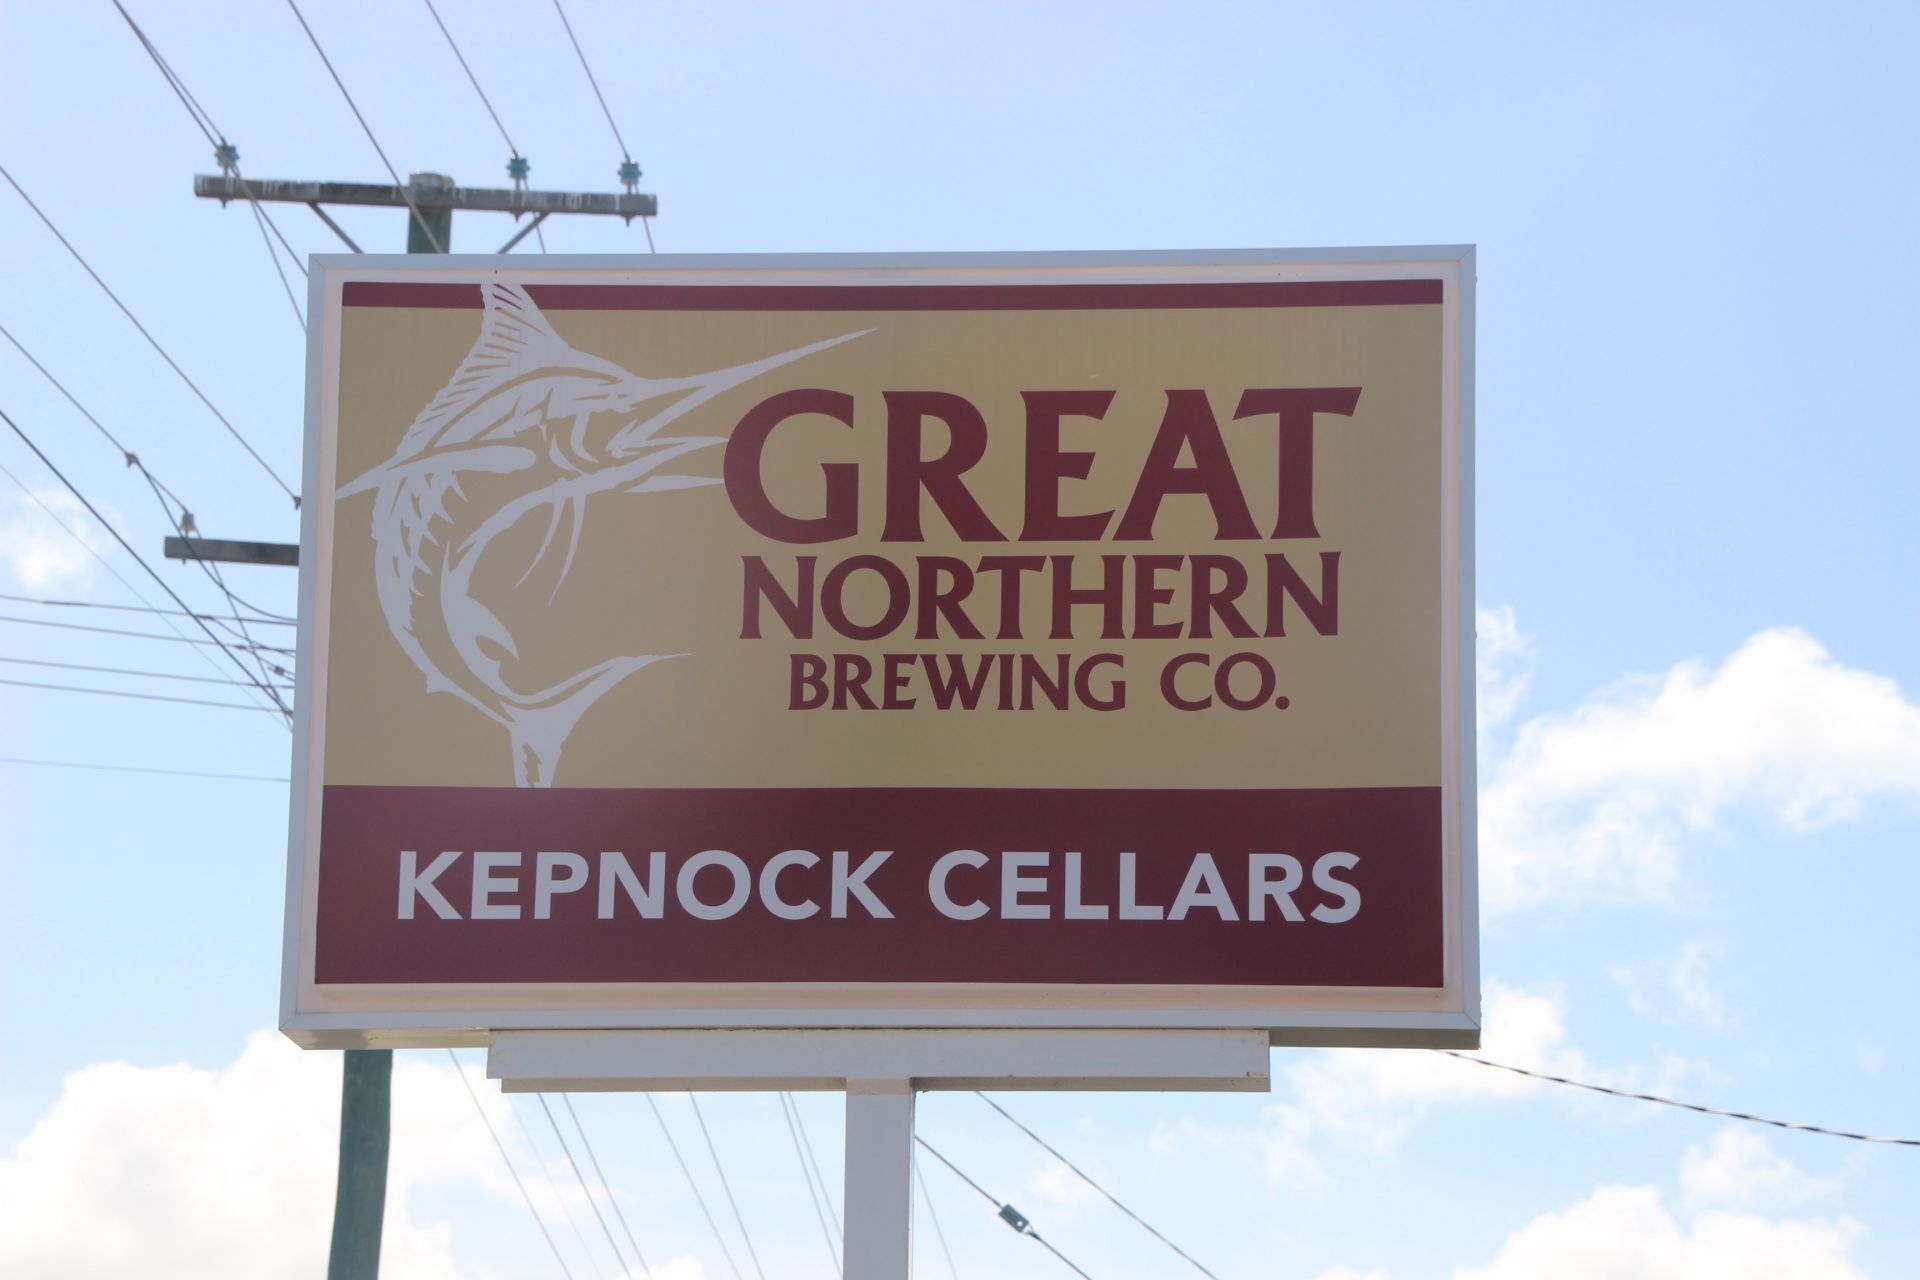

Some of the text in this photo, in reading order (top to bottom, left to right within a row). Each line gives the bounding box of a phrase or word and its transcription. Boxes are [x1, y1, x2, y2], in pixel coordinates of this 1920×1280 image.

[724, 387, 1362, 544] GREAT
[739, 551, 1341, 641] NORTHERN
[788, 652, 1290, 712] BREWING CO.
[398, 850, 1360, 923] KEPNOCK CELLARS
